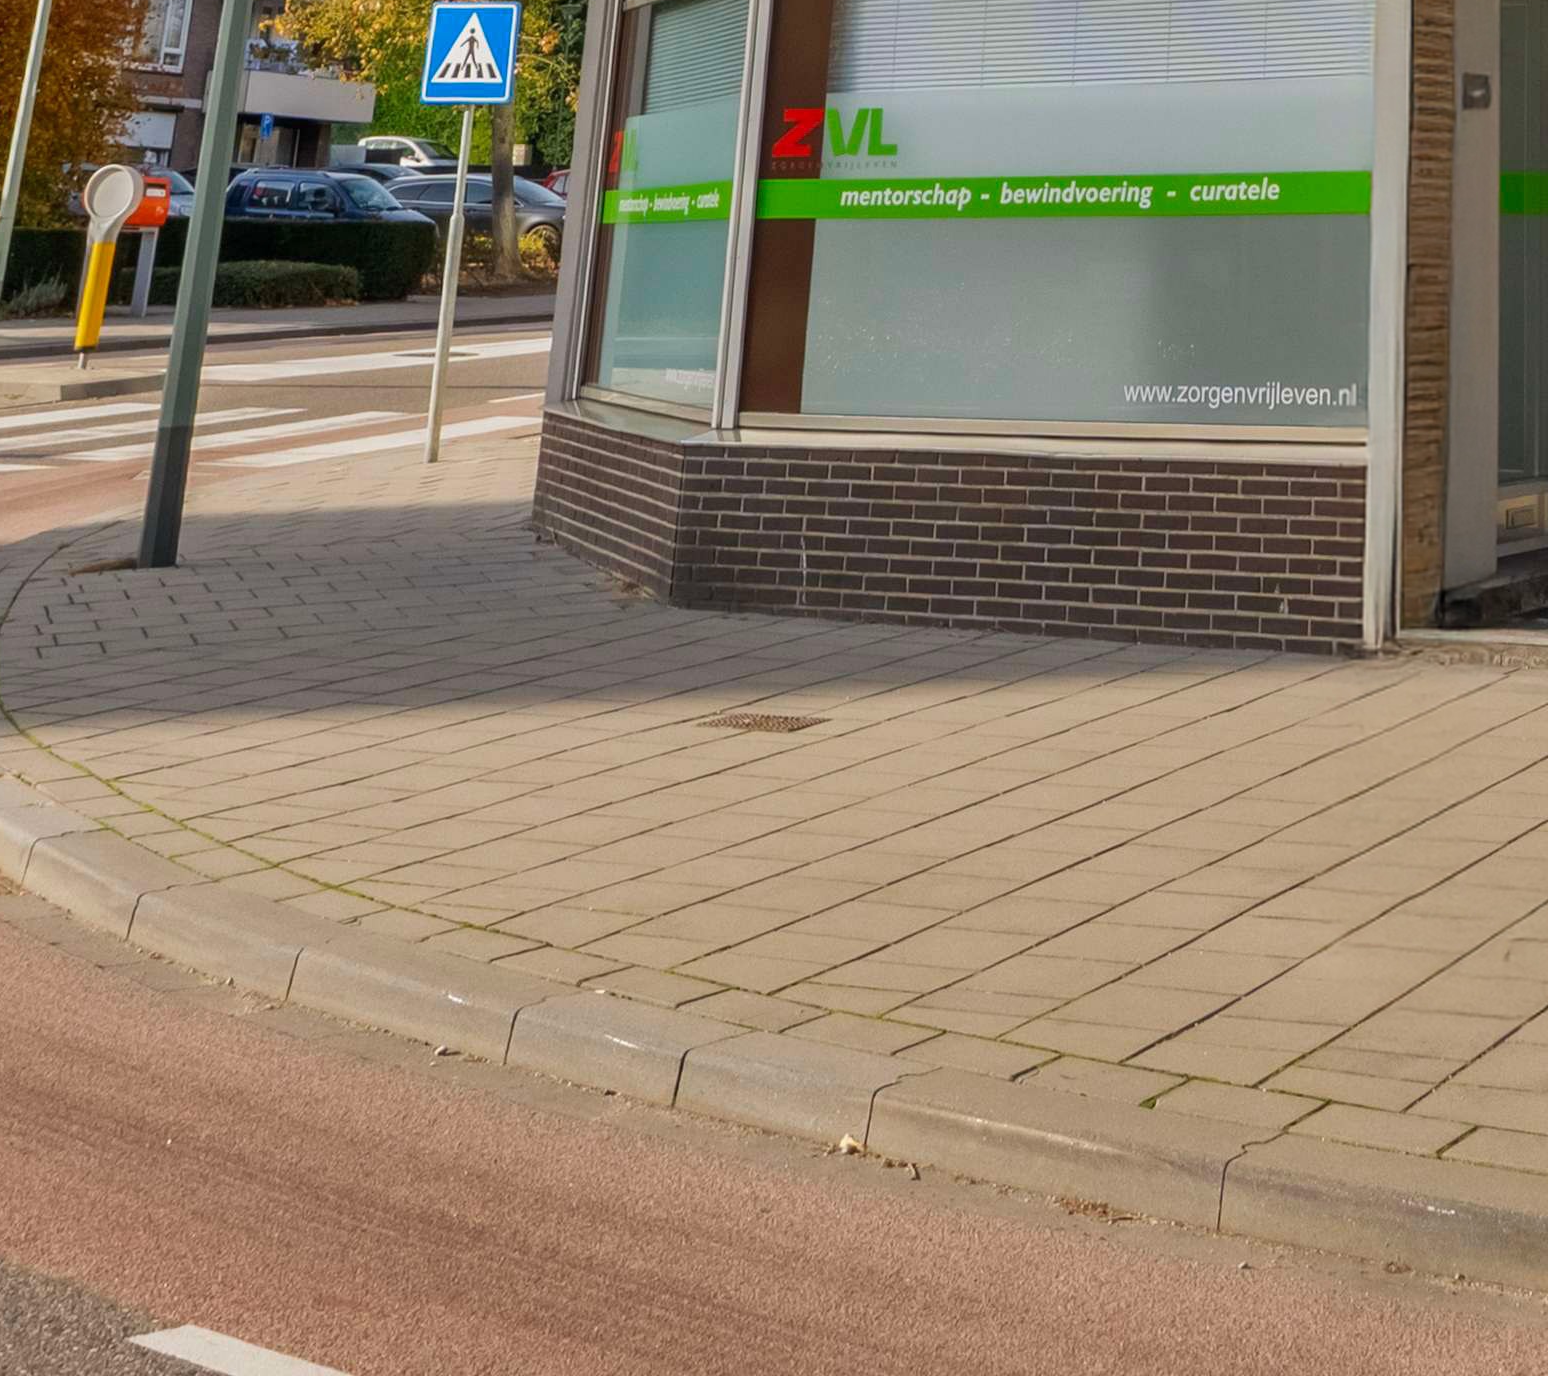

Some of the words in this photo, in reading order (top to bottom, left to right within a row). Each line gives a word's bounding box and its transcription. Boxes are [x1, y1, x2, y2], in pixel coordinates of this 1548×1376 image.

[772, 108, 898, 157] ZVL
[840, 183, 972, 211] mentorschap
[1000, 181, 1153, 209] bewindvoering
[1190, 177, 1280, 201] curatele
[1124, 381, 1357, 410] www.zorgenvrijleven.nl
